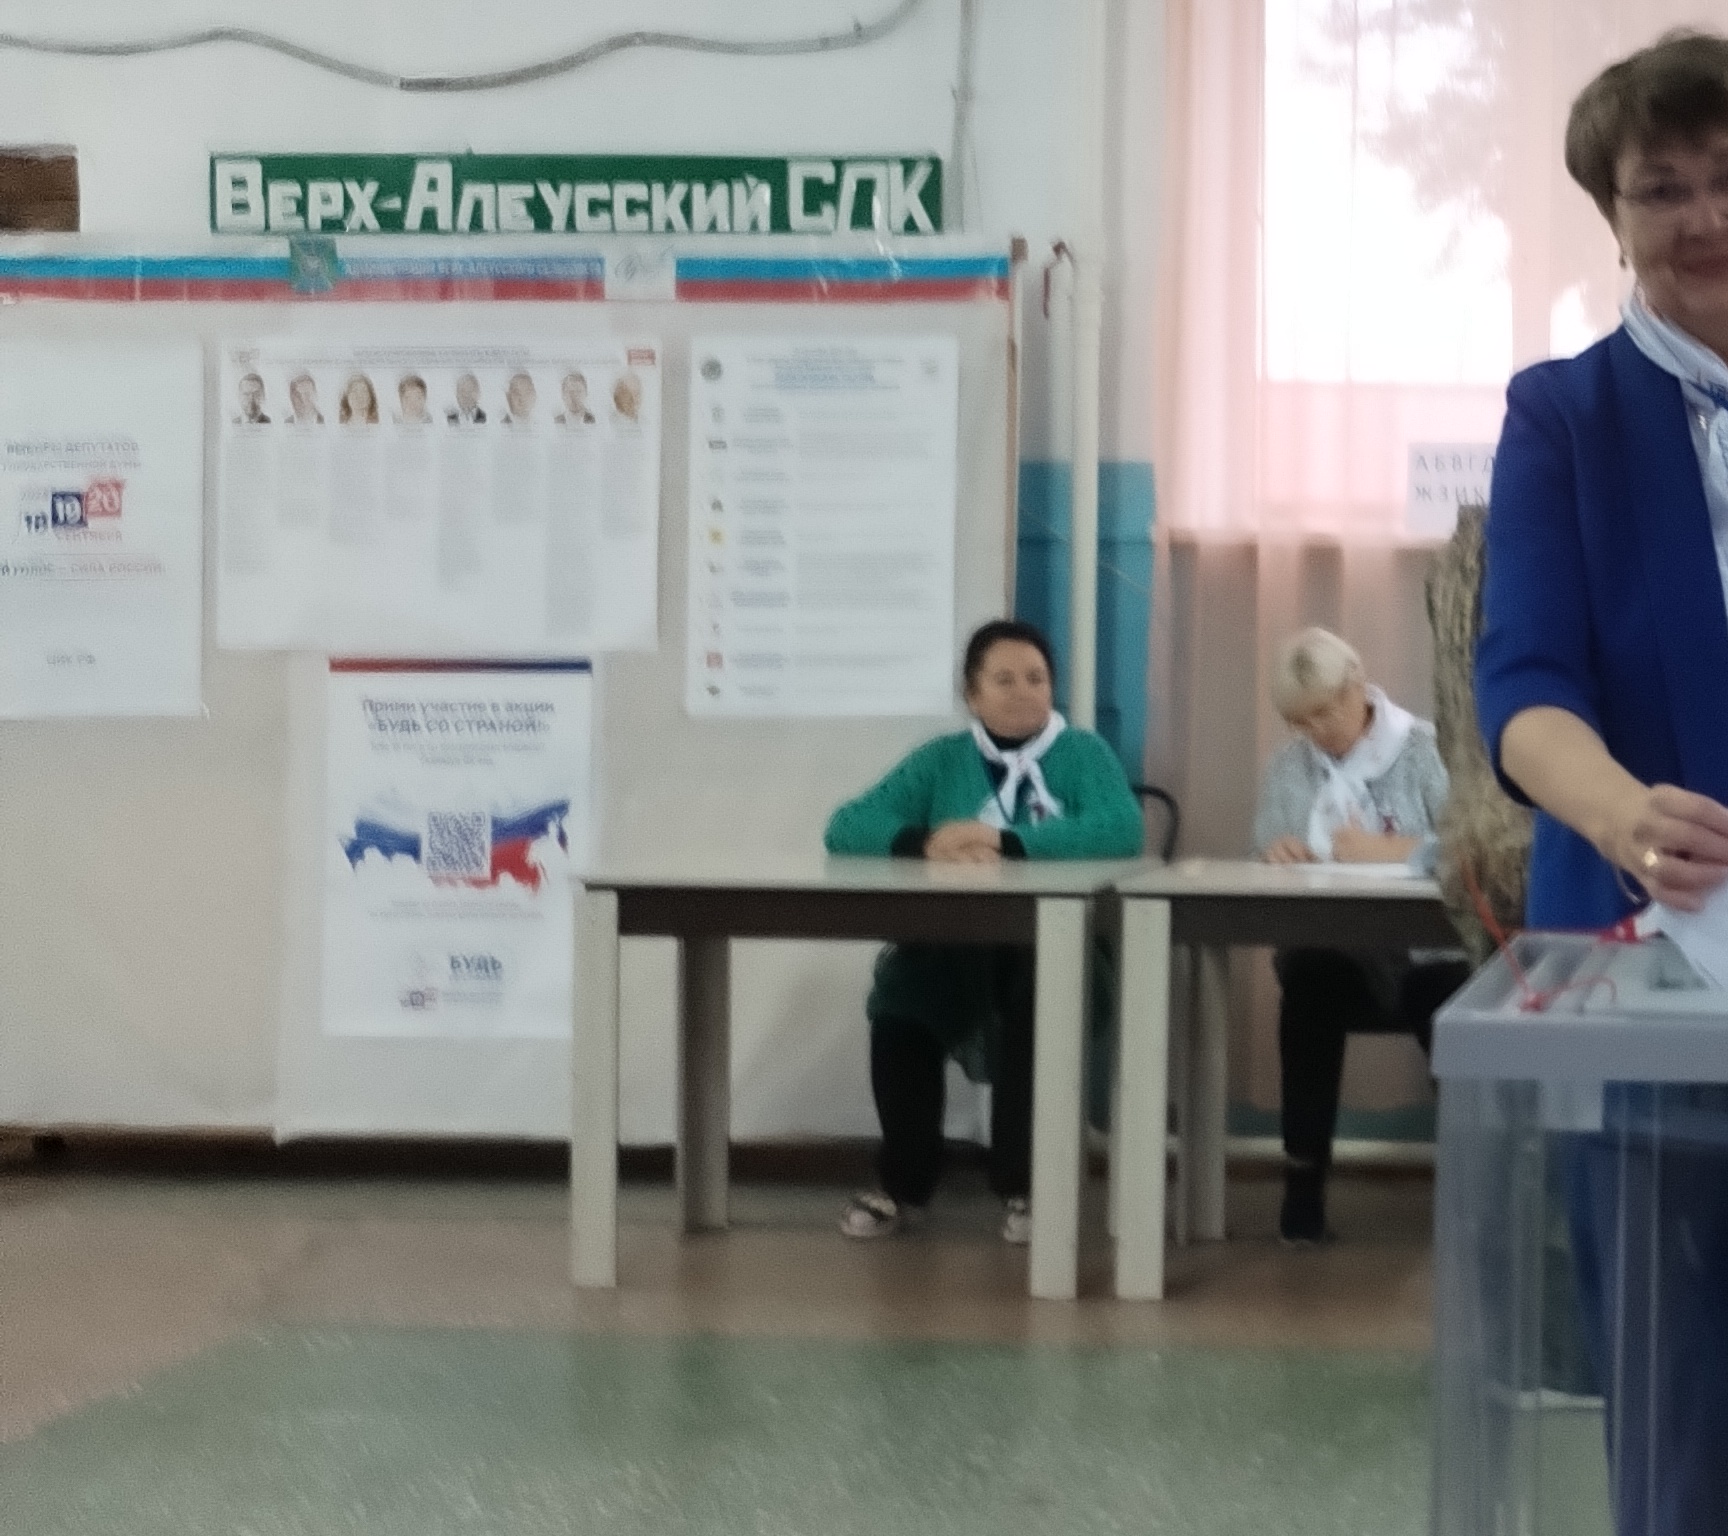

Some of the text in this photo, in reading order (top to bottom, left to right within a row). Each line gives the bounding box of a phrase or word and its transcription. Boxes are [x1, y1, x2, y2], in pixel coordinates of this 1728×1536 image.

[363, 699, 415, 715] Прими
[420, 701, 488, 716] участие
[505, 701, 554, 715] акции
